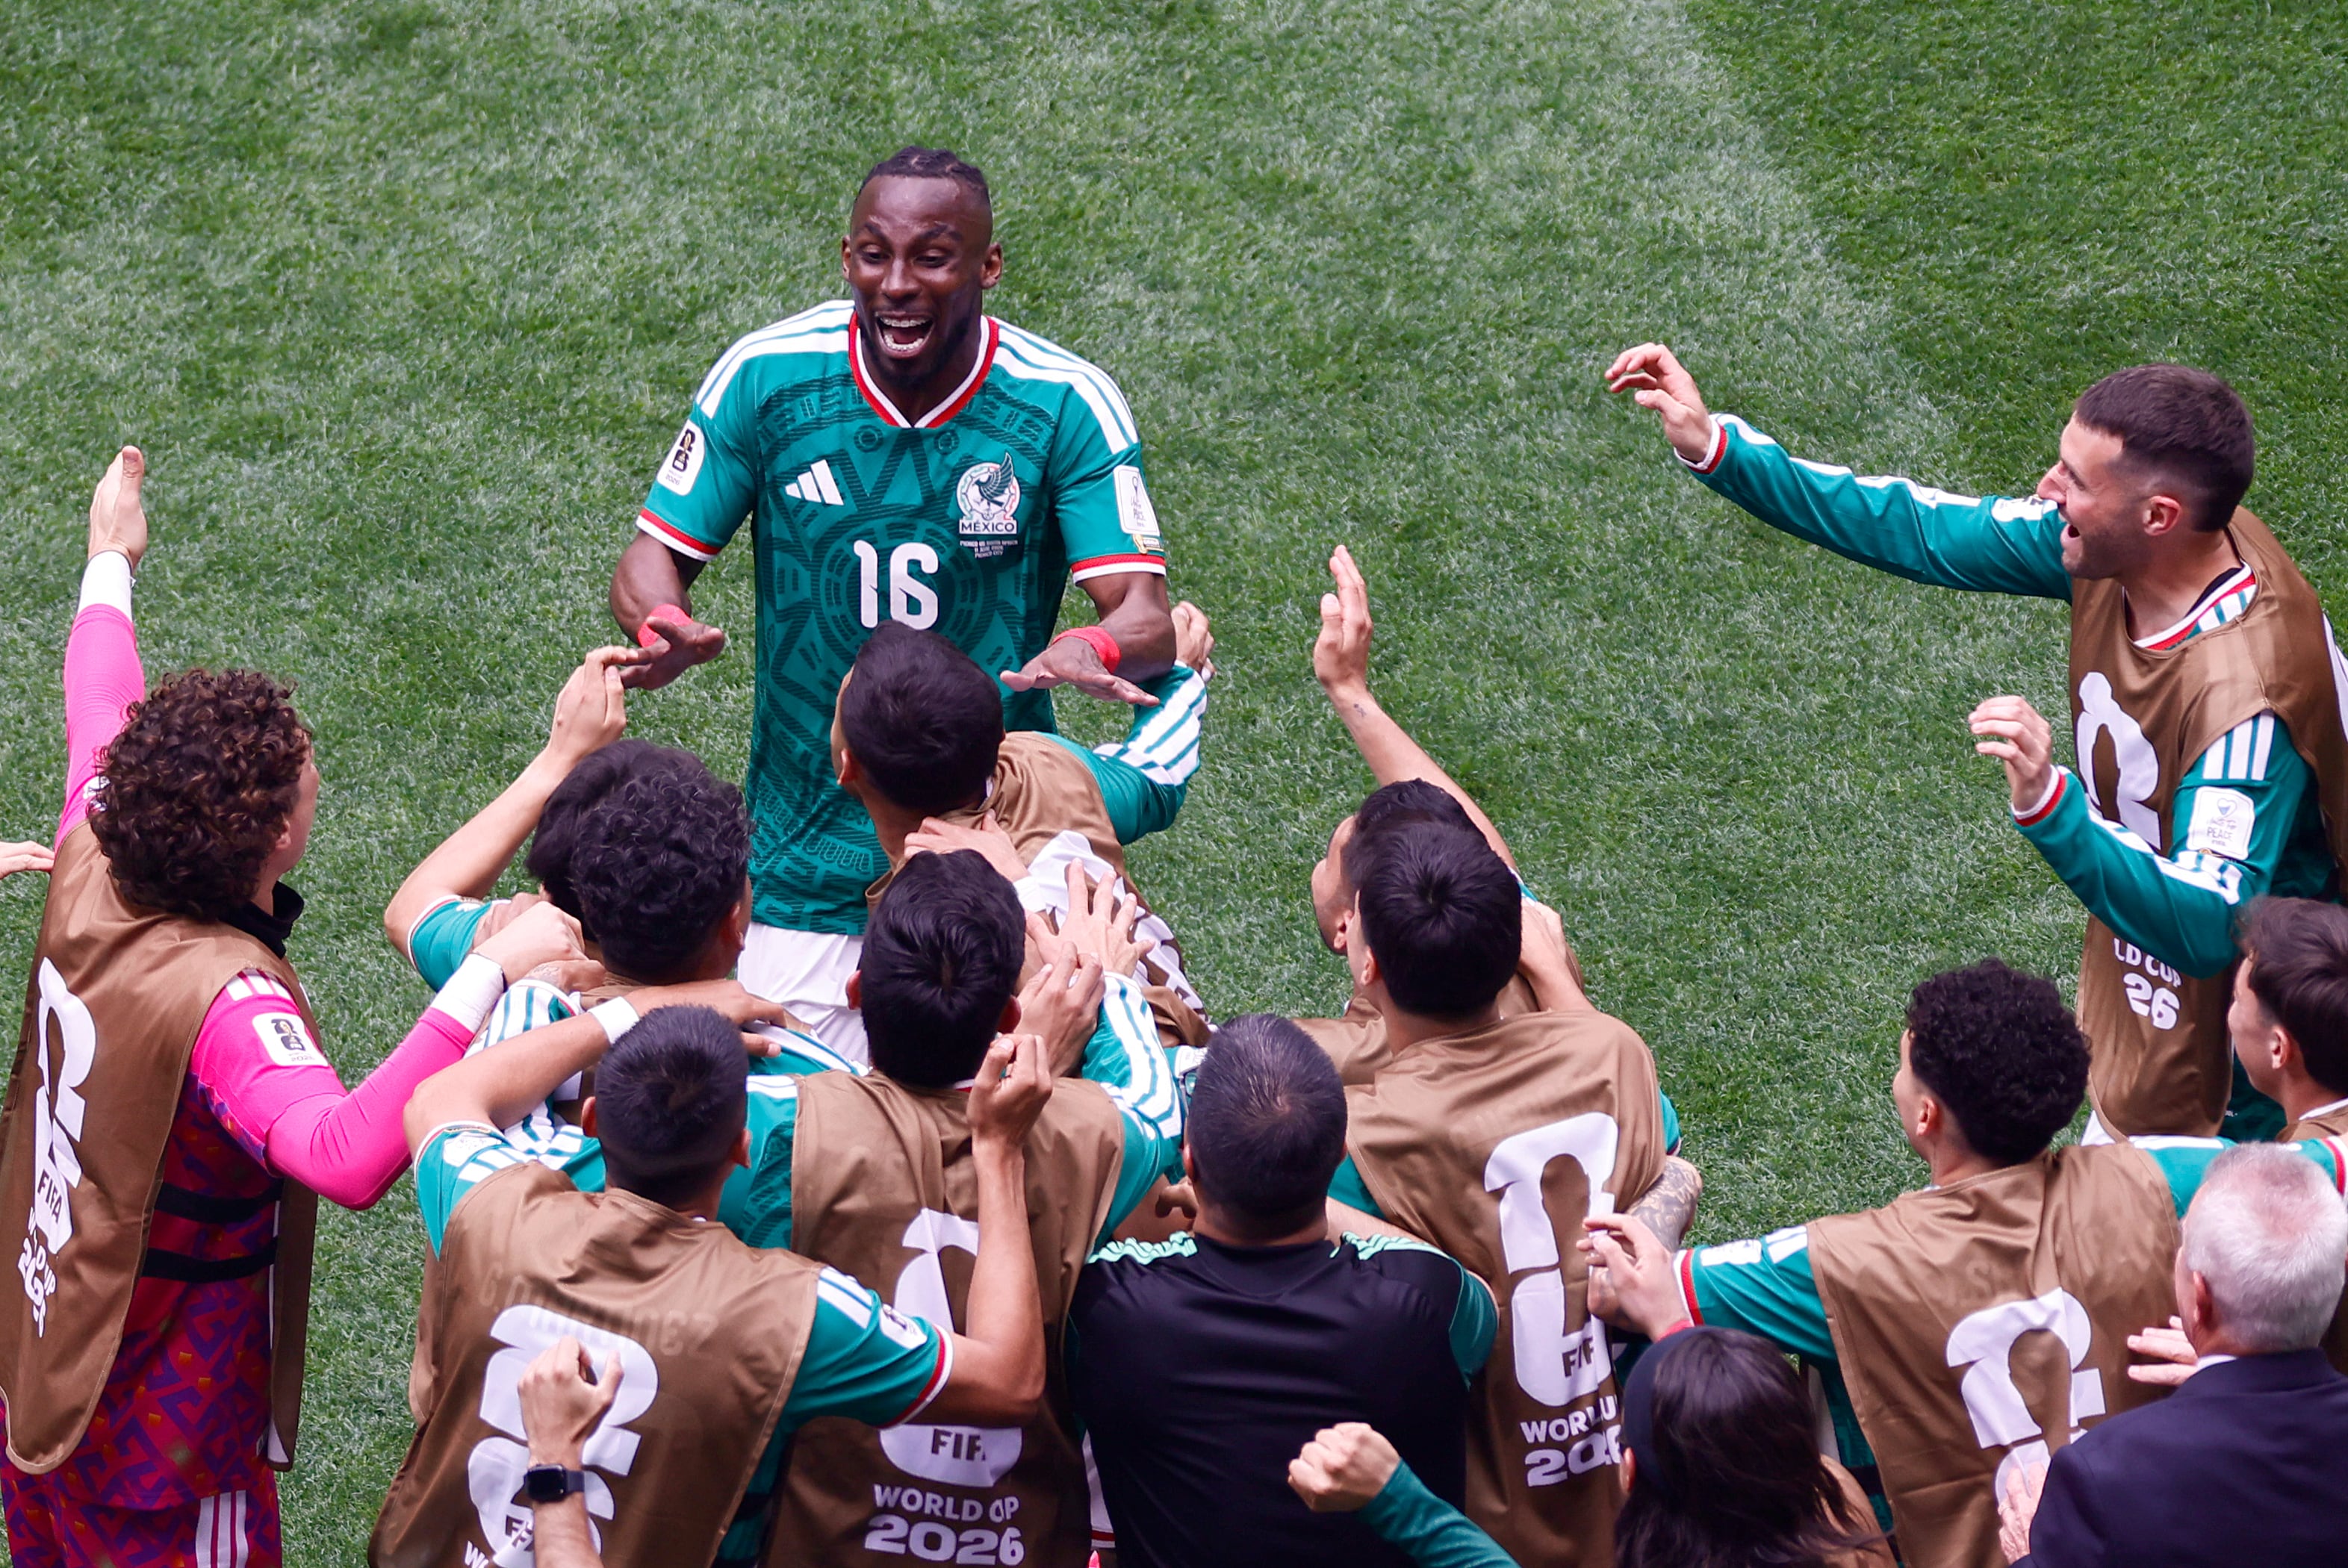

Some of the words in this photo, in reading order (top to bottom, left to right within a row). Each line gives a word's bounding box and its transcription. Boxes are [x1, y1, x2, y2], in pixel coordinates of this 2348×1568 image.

[961, 520, 1014, 532] MÉXICO
[854, 539, 939, 630] 16
[2207, 826, 2234, 842] PEACE
[37, 1169, 63, 1225] FIFA
[1562, 1336, 1595, 1378] FIF
[931, 1428, 986, 1462] FIF
[873, 1483, 984, 1522] WORLD
[864, 1513, 1025, 1567] 2026
